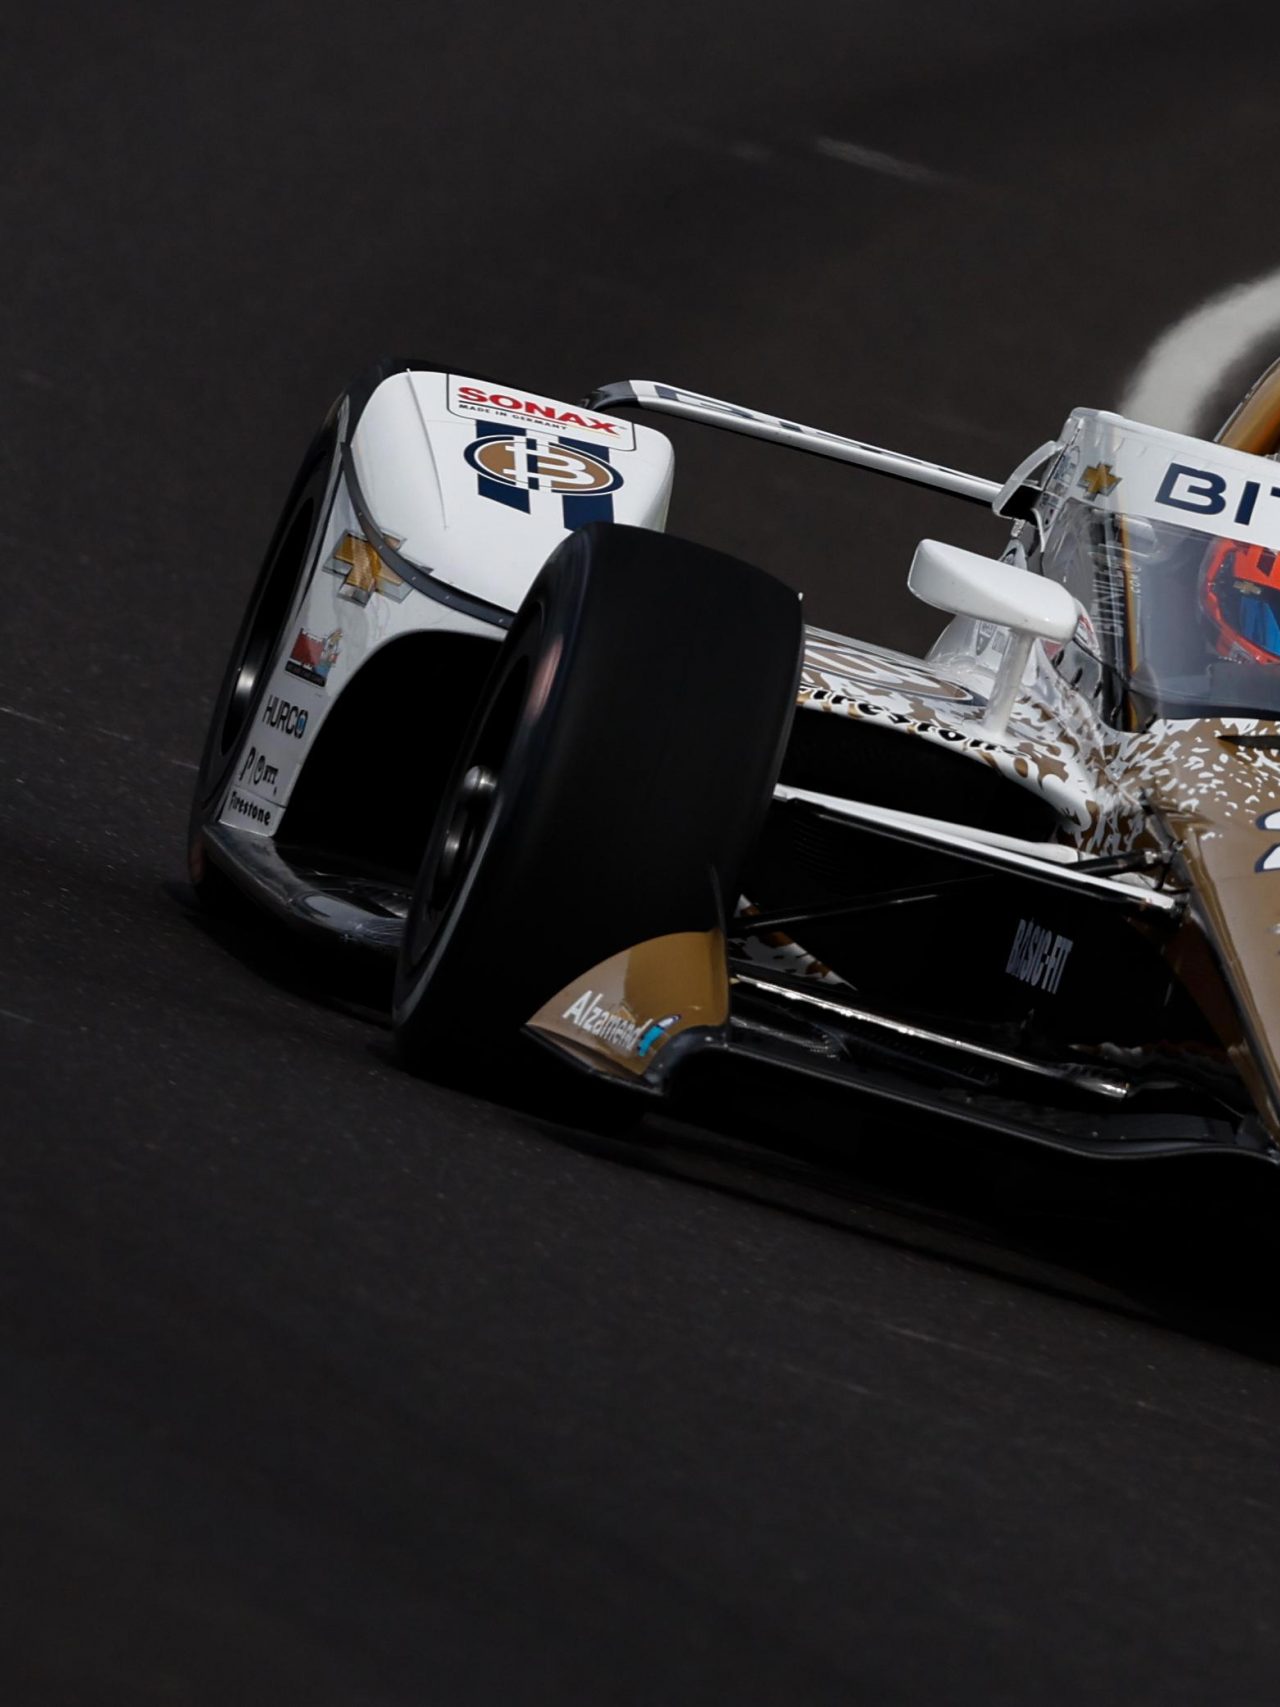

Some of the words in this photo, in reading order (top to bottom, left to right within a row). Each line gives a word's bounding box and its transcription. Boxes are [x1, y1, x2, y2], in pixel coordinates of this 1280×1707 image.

[458, 387, 620, 435] SONAX
[458, 404, 491, 414] MADE
[512, 414, 567, 431] GERMANY
[261, 695, 308, 739] HURCO
[229, 791, 272, 826] Firestone
[562, 990, 653, 1052] Alzamend
